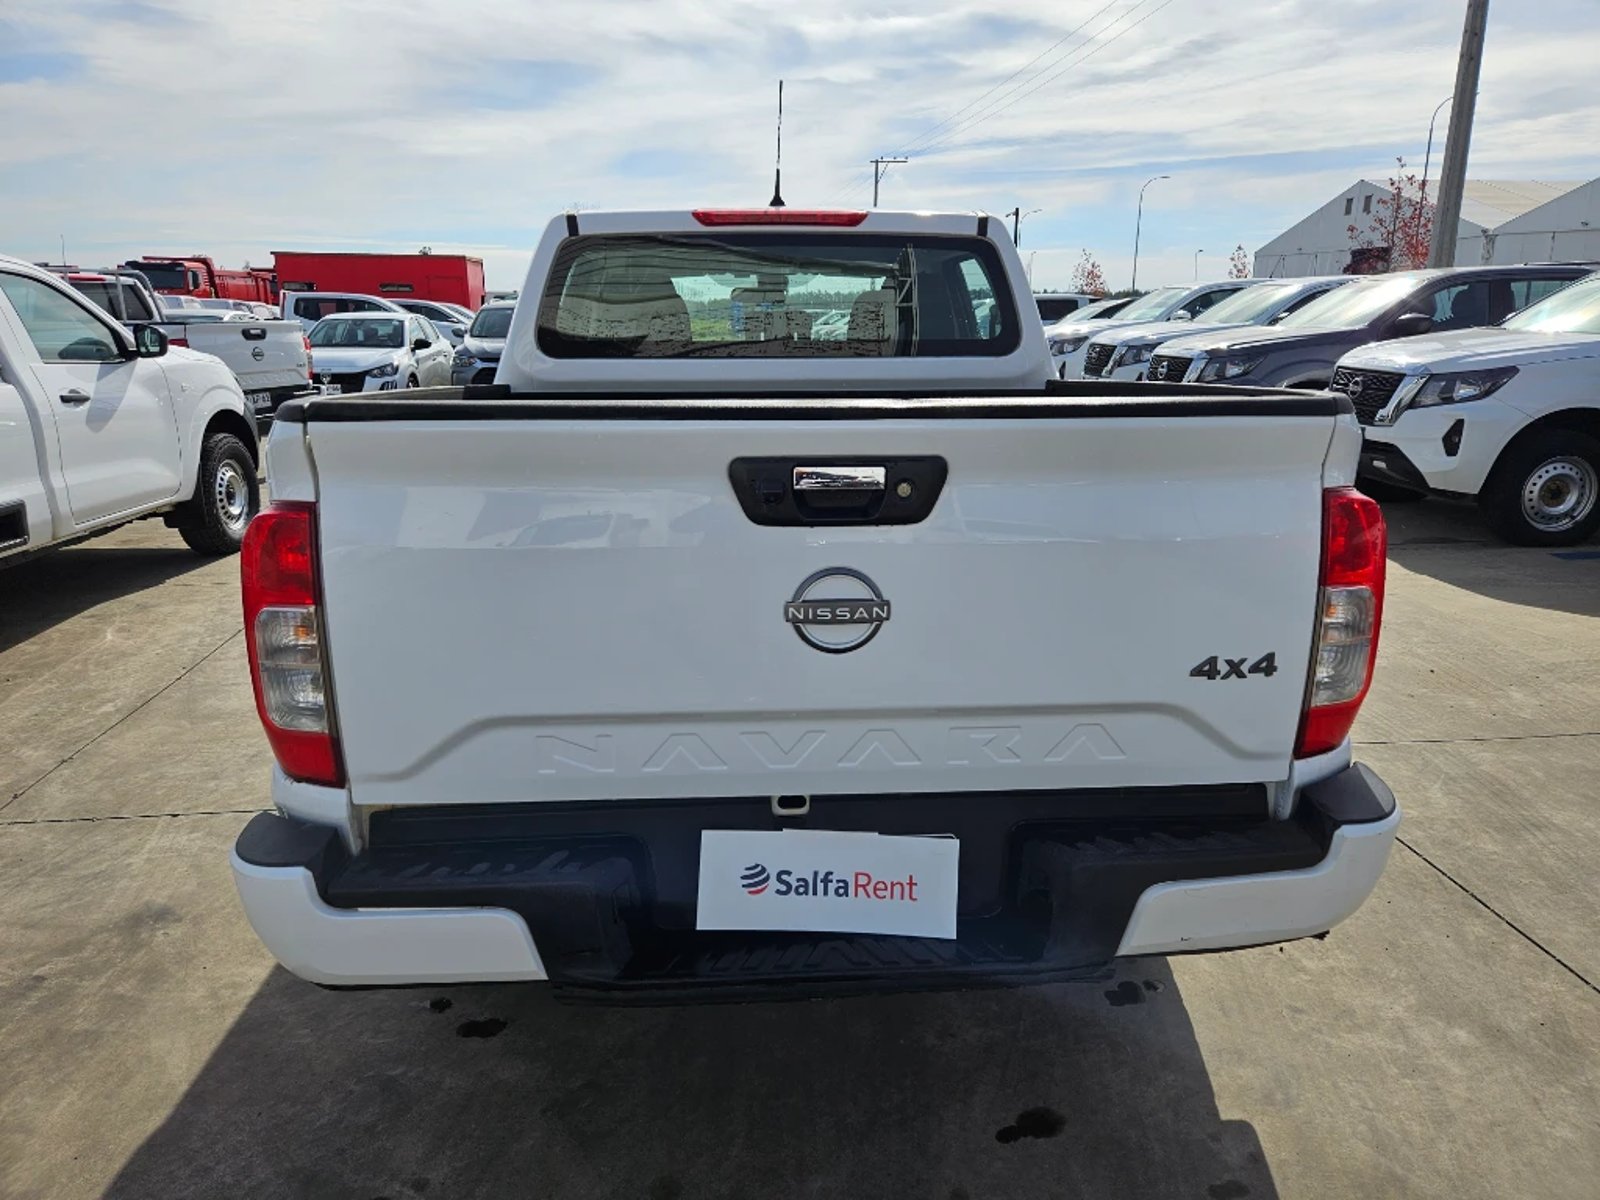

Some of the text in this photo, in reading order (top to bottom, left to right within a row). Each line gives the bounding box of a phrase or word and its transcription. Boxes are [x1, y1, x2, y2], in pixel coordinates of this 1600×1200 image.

[788, 605, 888, 620] NISSAN
[1189, 651, 1278, 680] 4x4
[536, 723, 1127, 774] NAVARA
[774, 869, 918, 901] SalfaRent
